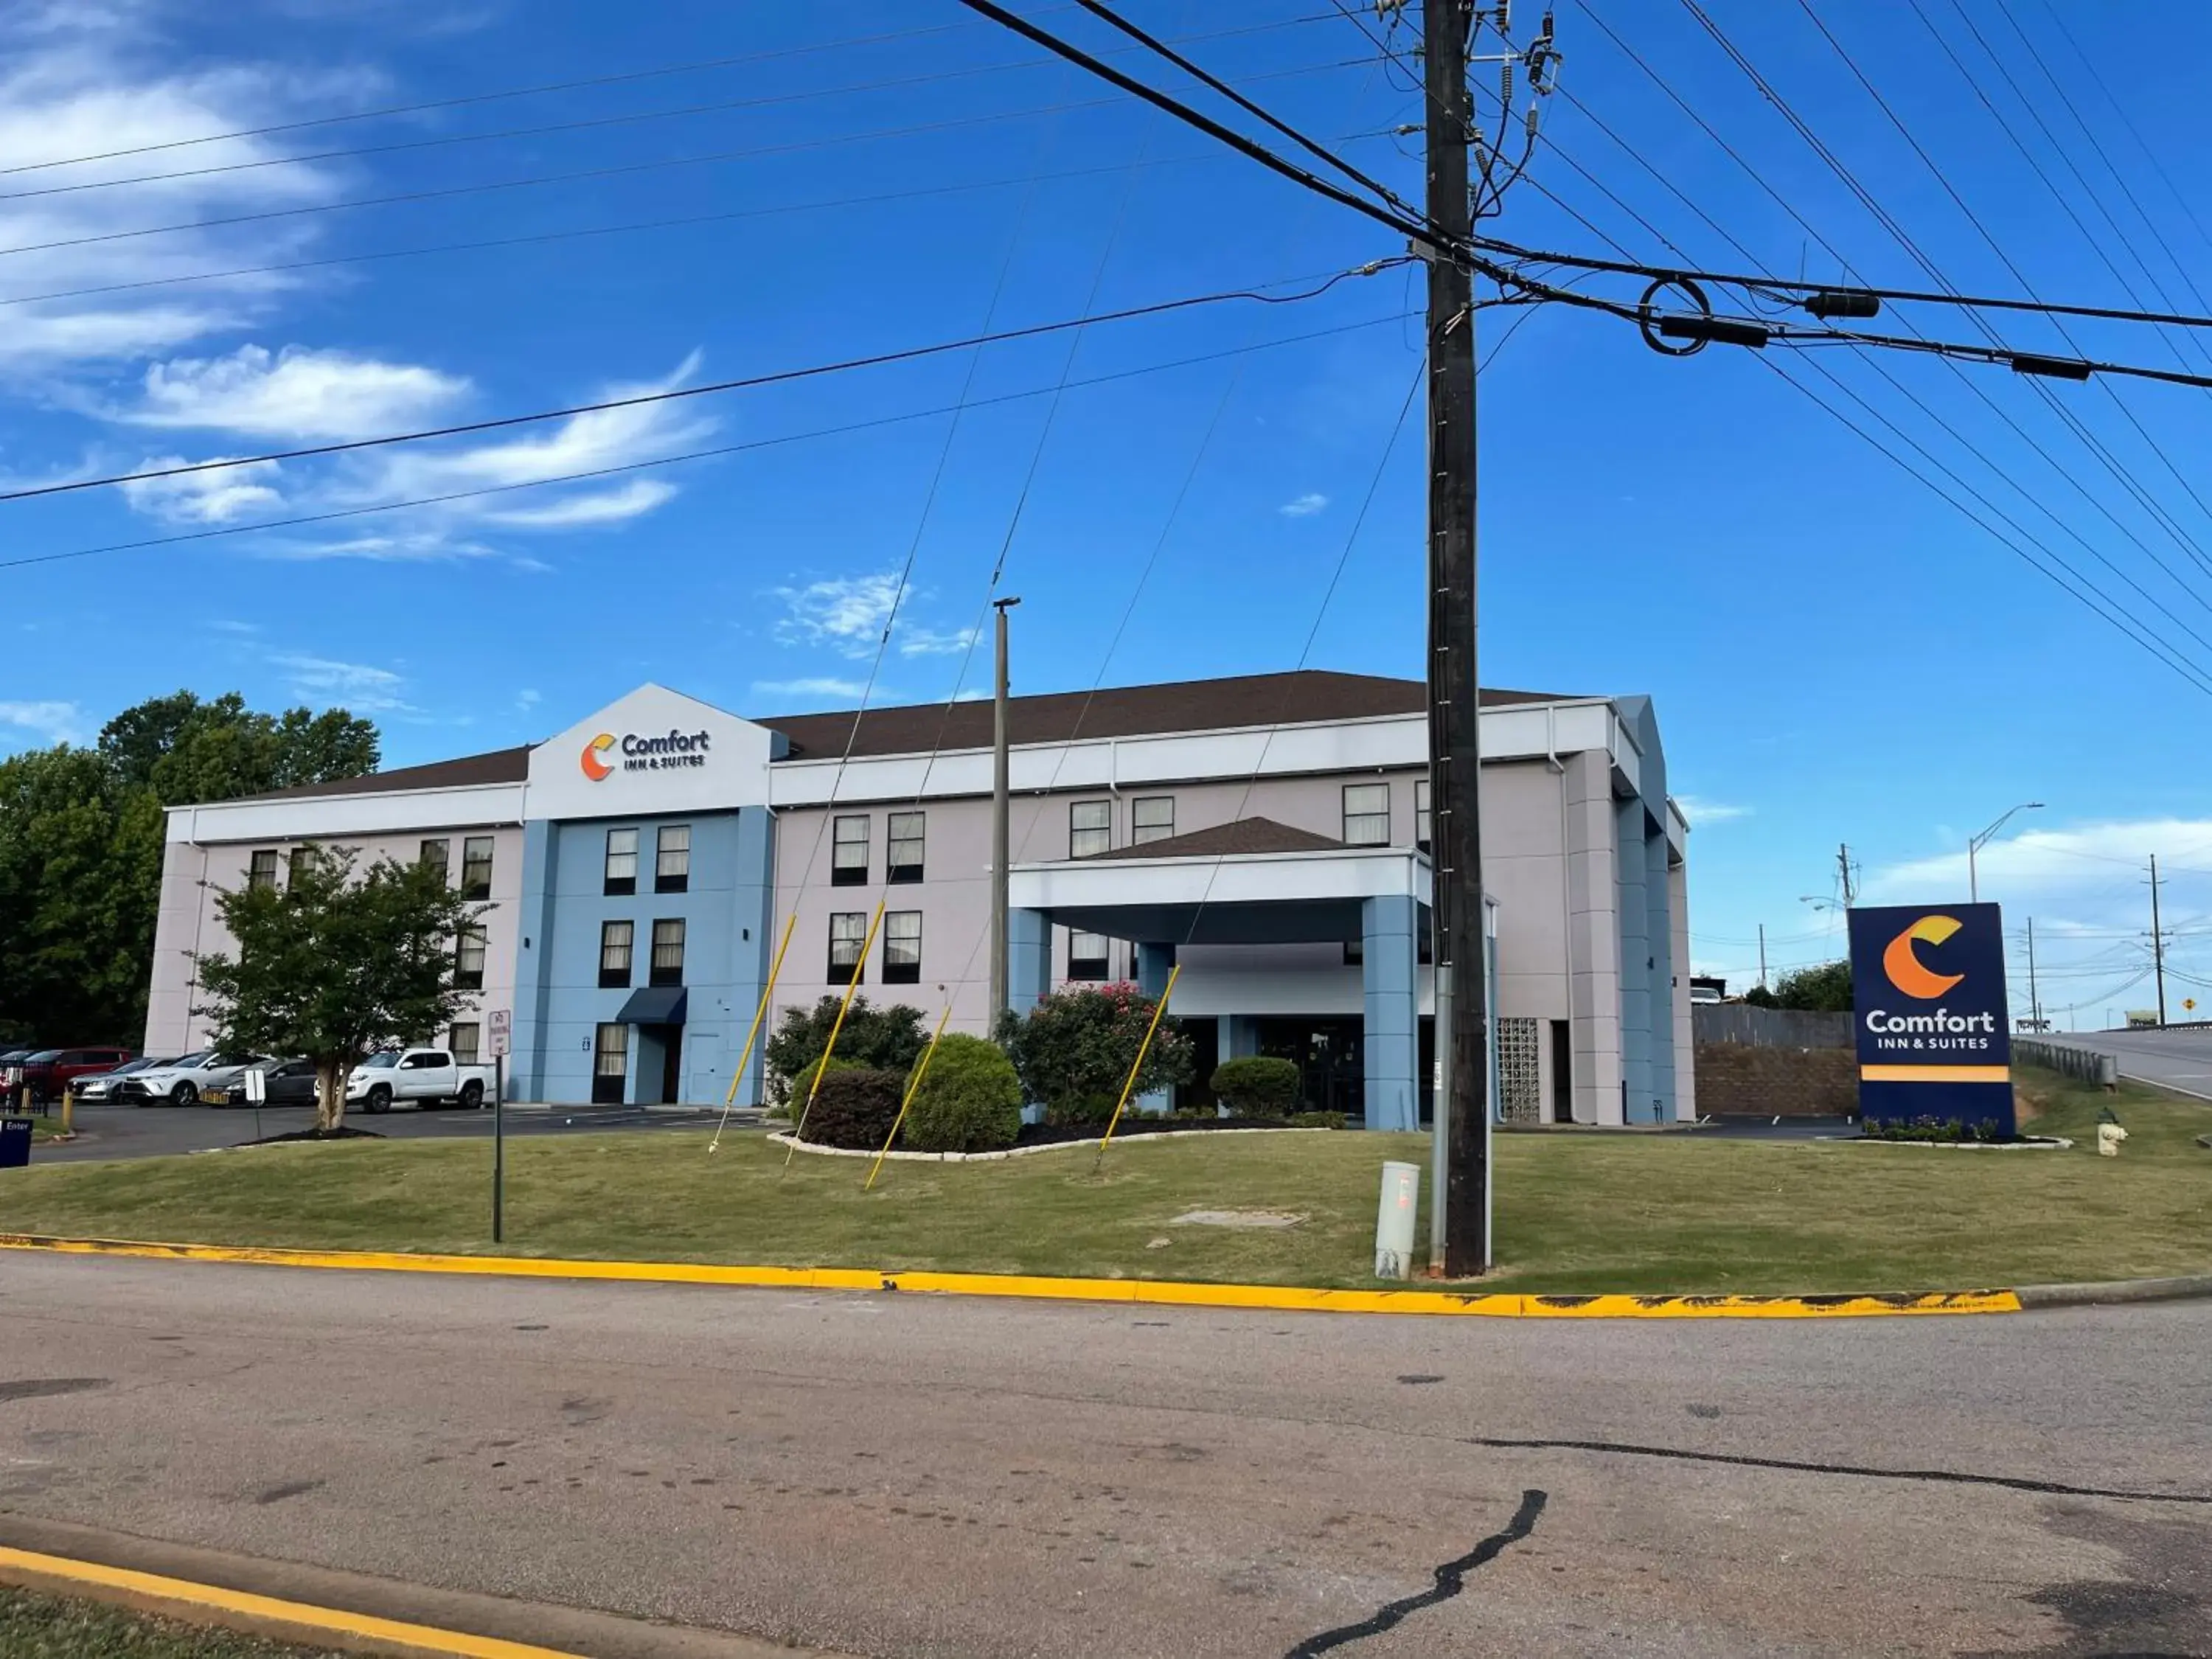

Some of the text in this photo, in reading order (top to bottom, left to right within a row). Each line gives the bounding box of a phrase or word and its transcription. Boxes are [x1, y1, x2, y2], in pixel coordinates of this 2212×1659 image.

[622, 729, 710, 756] Comfort
[625, 754, 705, 771] INN & SUITES
[1866, 1008, 1994, 1033] Comfort
[1878, 1037, 1988, 1049] INN & SUITES
